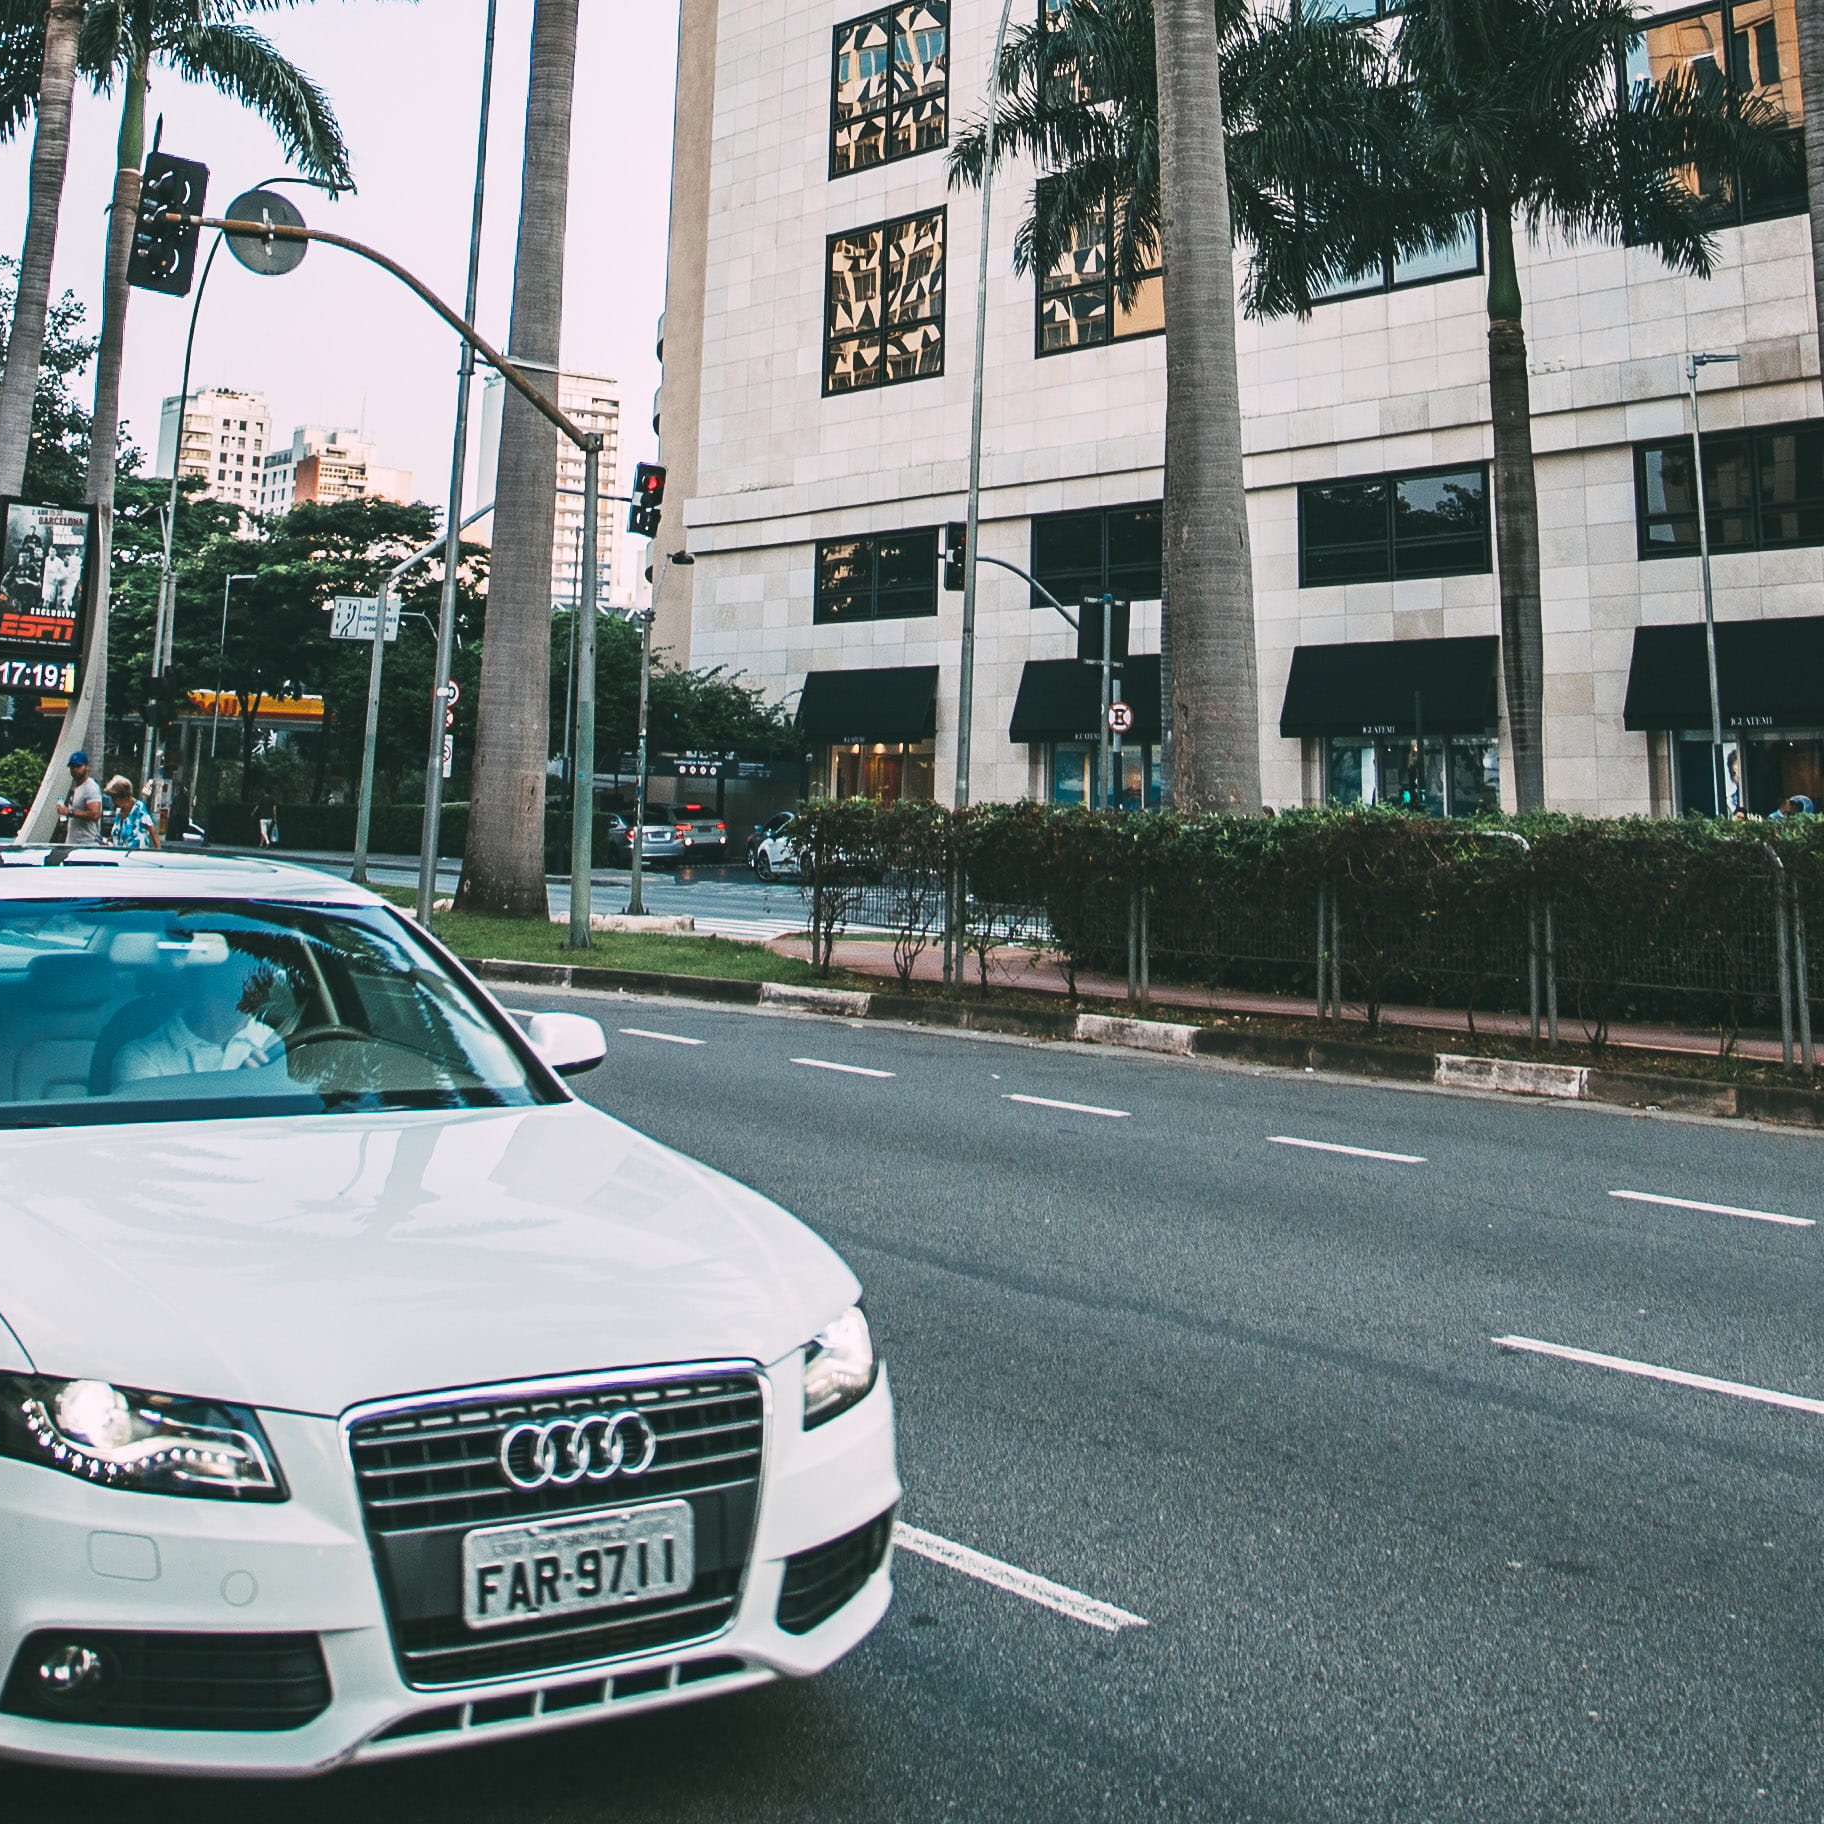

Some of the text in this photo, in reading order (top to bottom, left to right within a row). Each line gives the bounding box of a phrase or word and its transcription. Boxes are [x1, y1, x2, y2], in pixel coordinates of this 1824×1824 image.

[38, 515, 84, 526] BARCELONA
[30, 607, 76, 619] EXCLUSIVO
[0, 613, 75, 641] ESPN
[476, 1538, 674, 1614] FAR-9711
